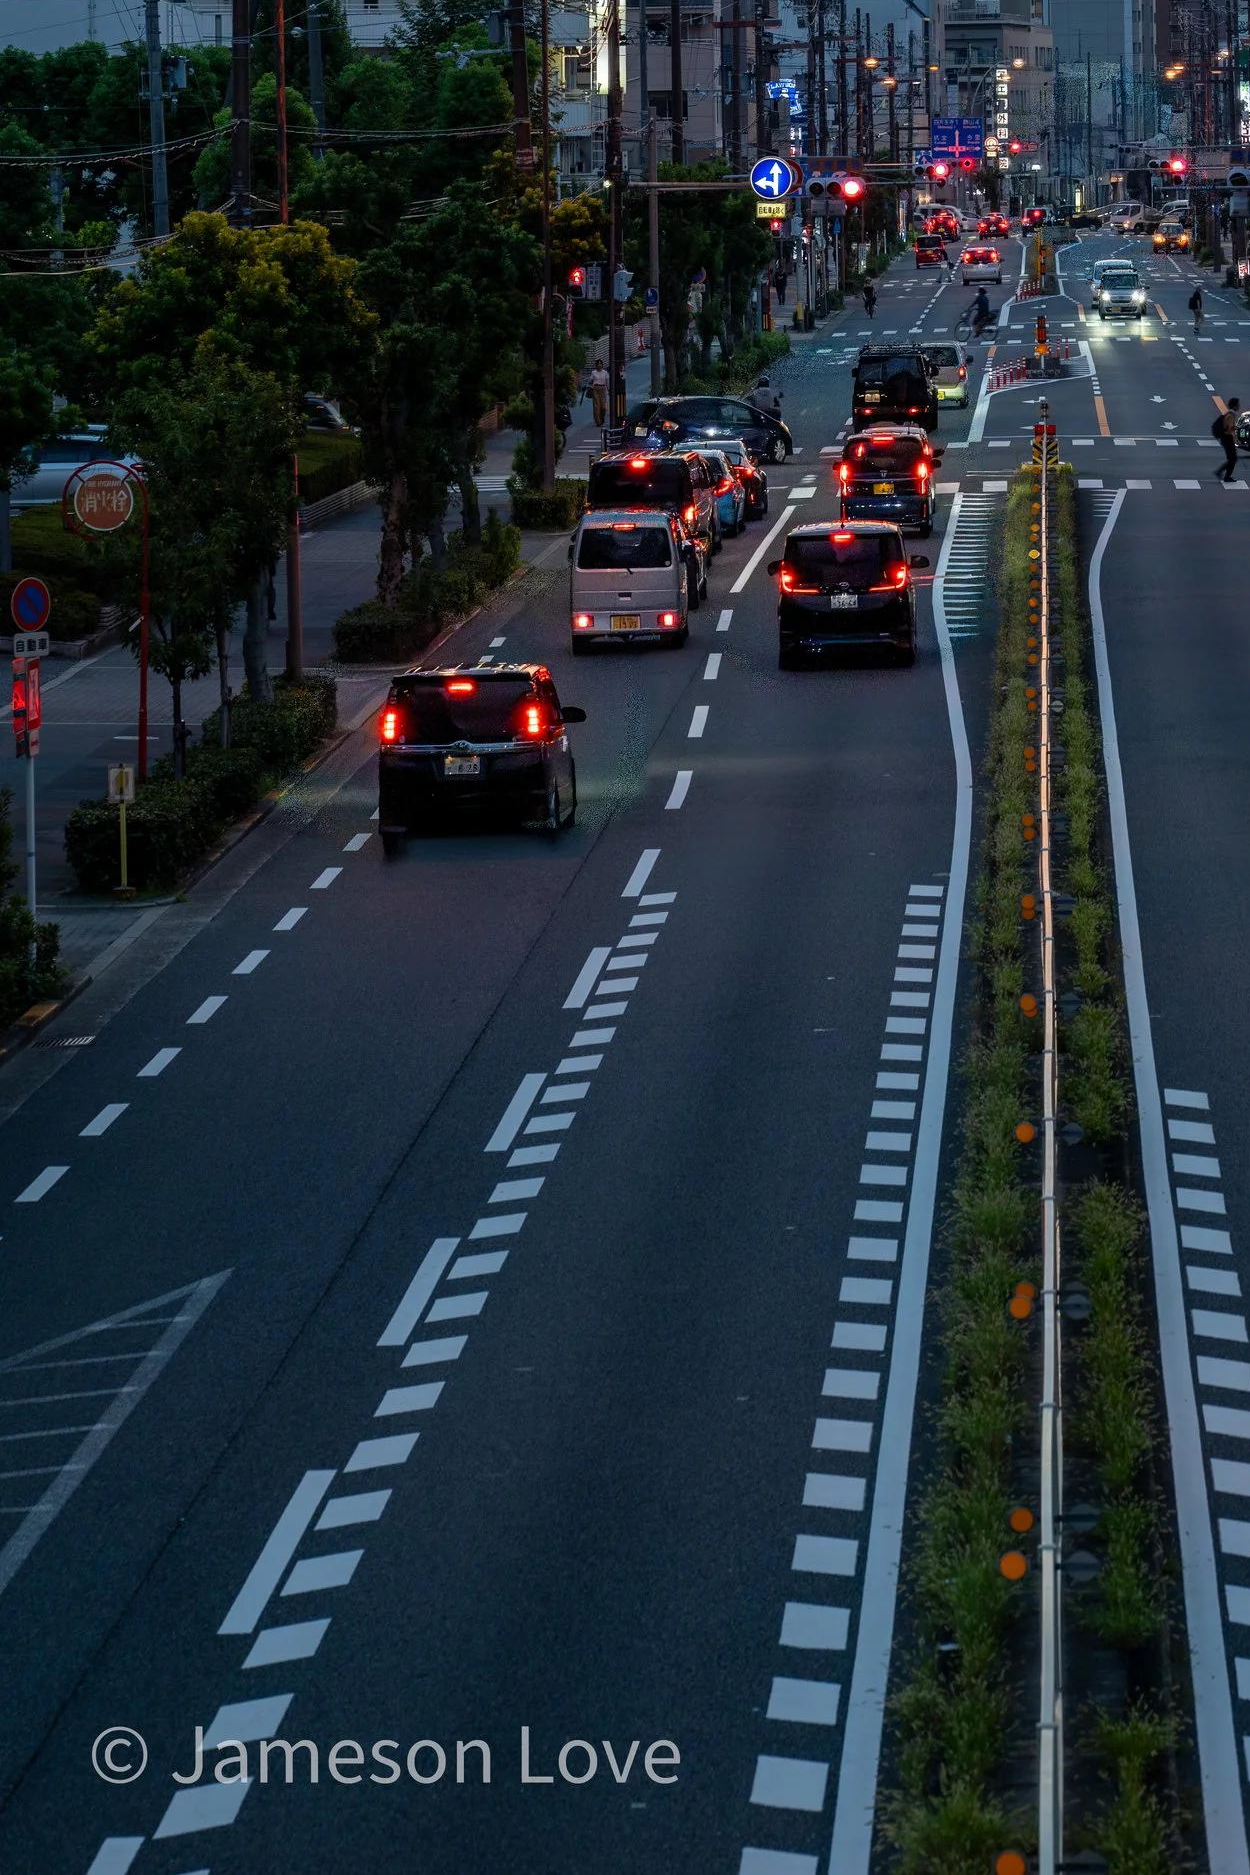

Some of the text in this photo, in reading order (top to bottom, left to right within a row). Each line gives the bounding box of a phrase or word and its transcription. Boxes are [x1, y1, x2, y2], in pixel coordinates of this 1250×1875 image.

[97, 480, 122, 488] HYDRANT
[81, 489, 128, 514] 消火栓
[16, 637, 48, 653] 自動車
